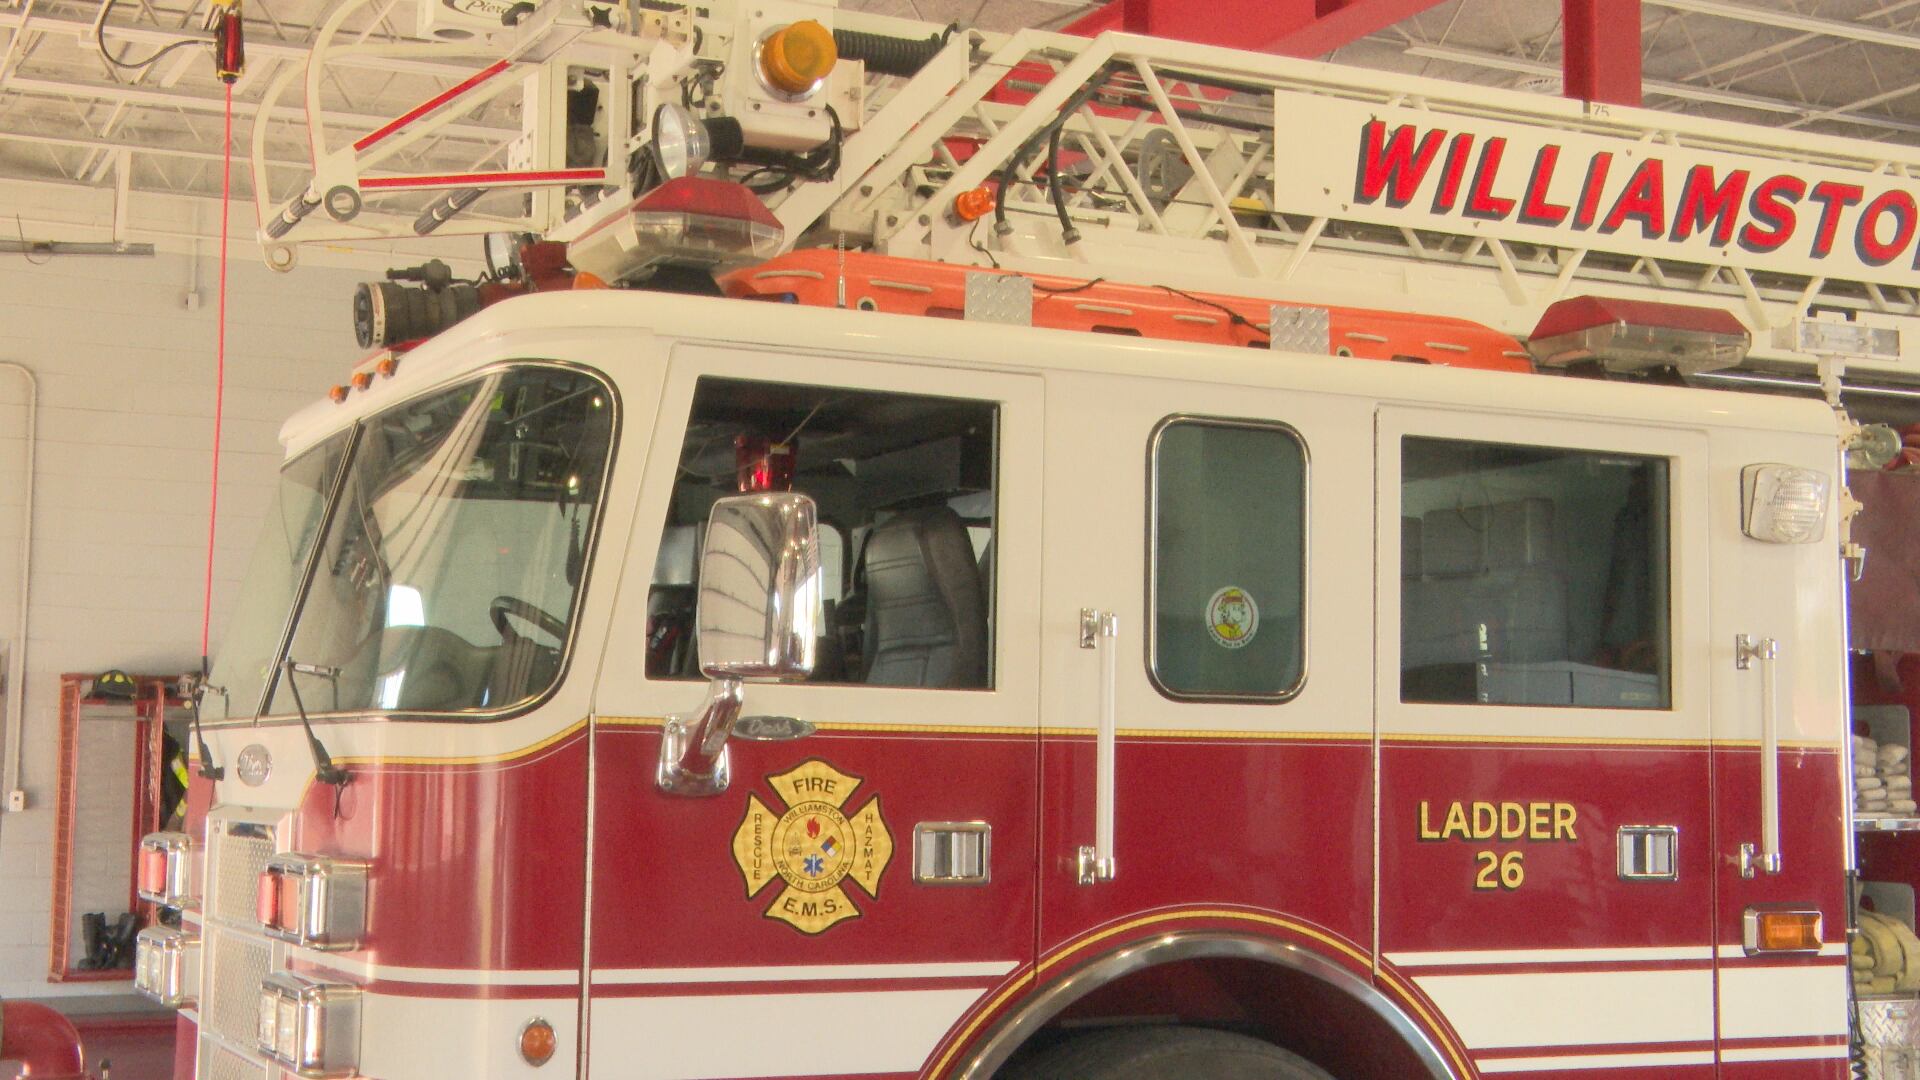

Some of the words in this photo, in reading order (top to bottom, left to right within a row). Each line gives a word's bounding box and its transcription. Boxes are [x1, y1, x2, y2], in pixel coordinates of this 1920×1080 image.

[1593, 103, 1610, 117] 75
[1354, 120, 1920, 271] WILLIAMSTO
[793, 777, 838, 795] FIRE
[783, 804, 845, 825] WILLIAMSTON
[1418, 800, 1577, 841] LADDER
[753, 813, 763, 881] RESCUE
[863, 813, 873, 881] HAZMAT
[777, 859, 804, 889] NORTH
[807, 862, 850, 891] CAROLINA
[1474, 850, 1525, 889] 26
[783, 897, 843, 916] E.M.S.
